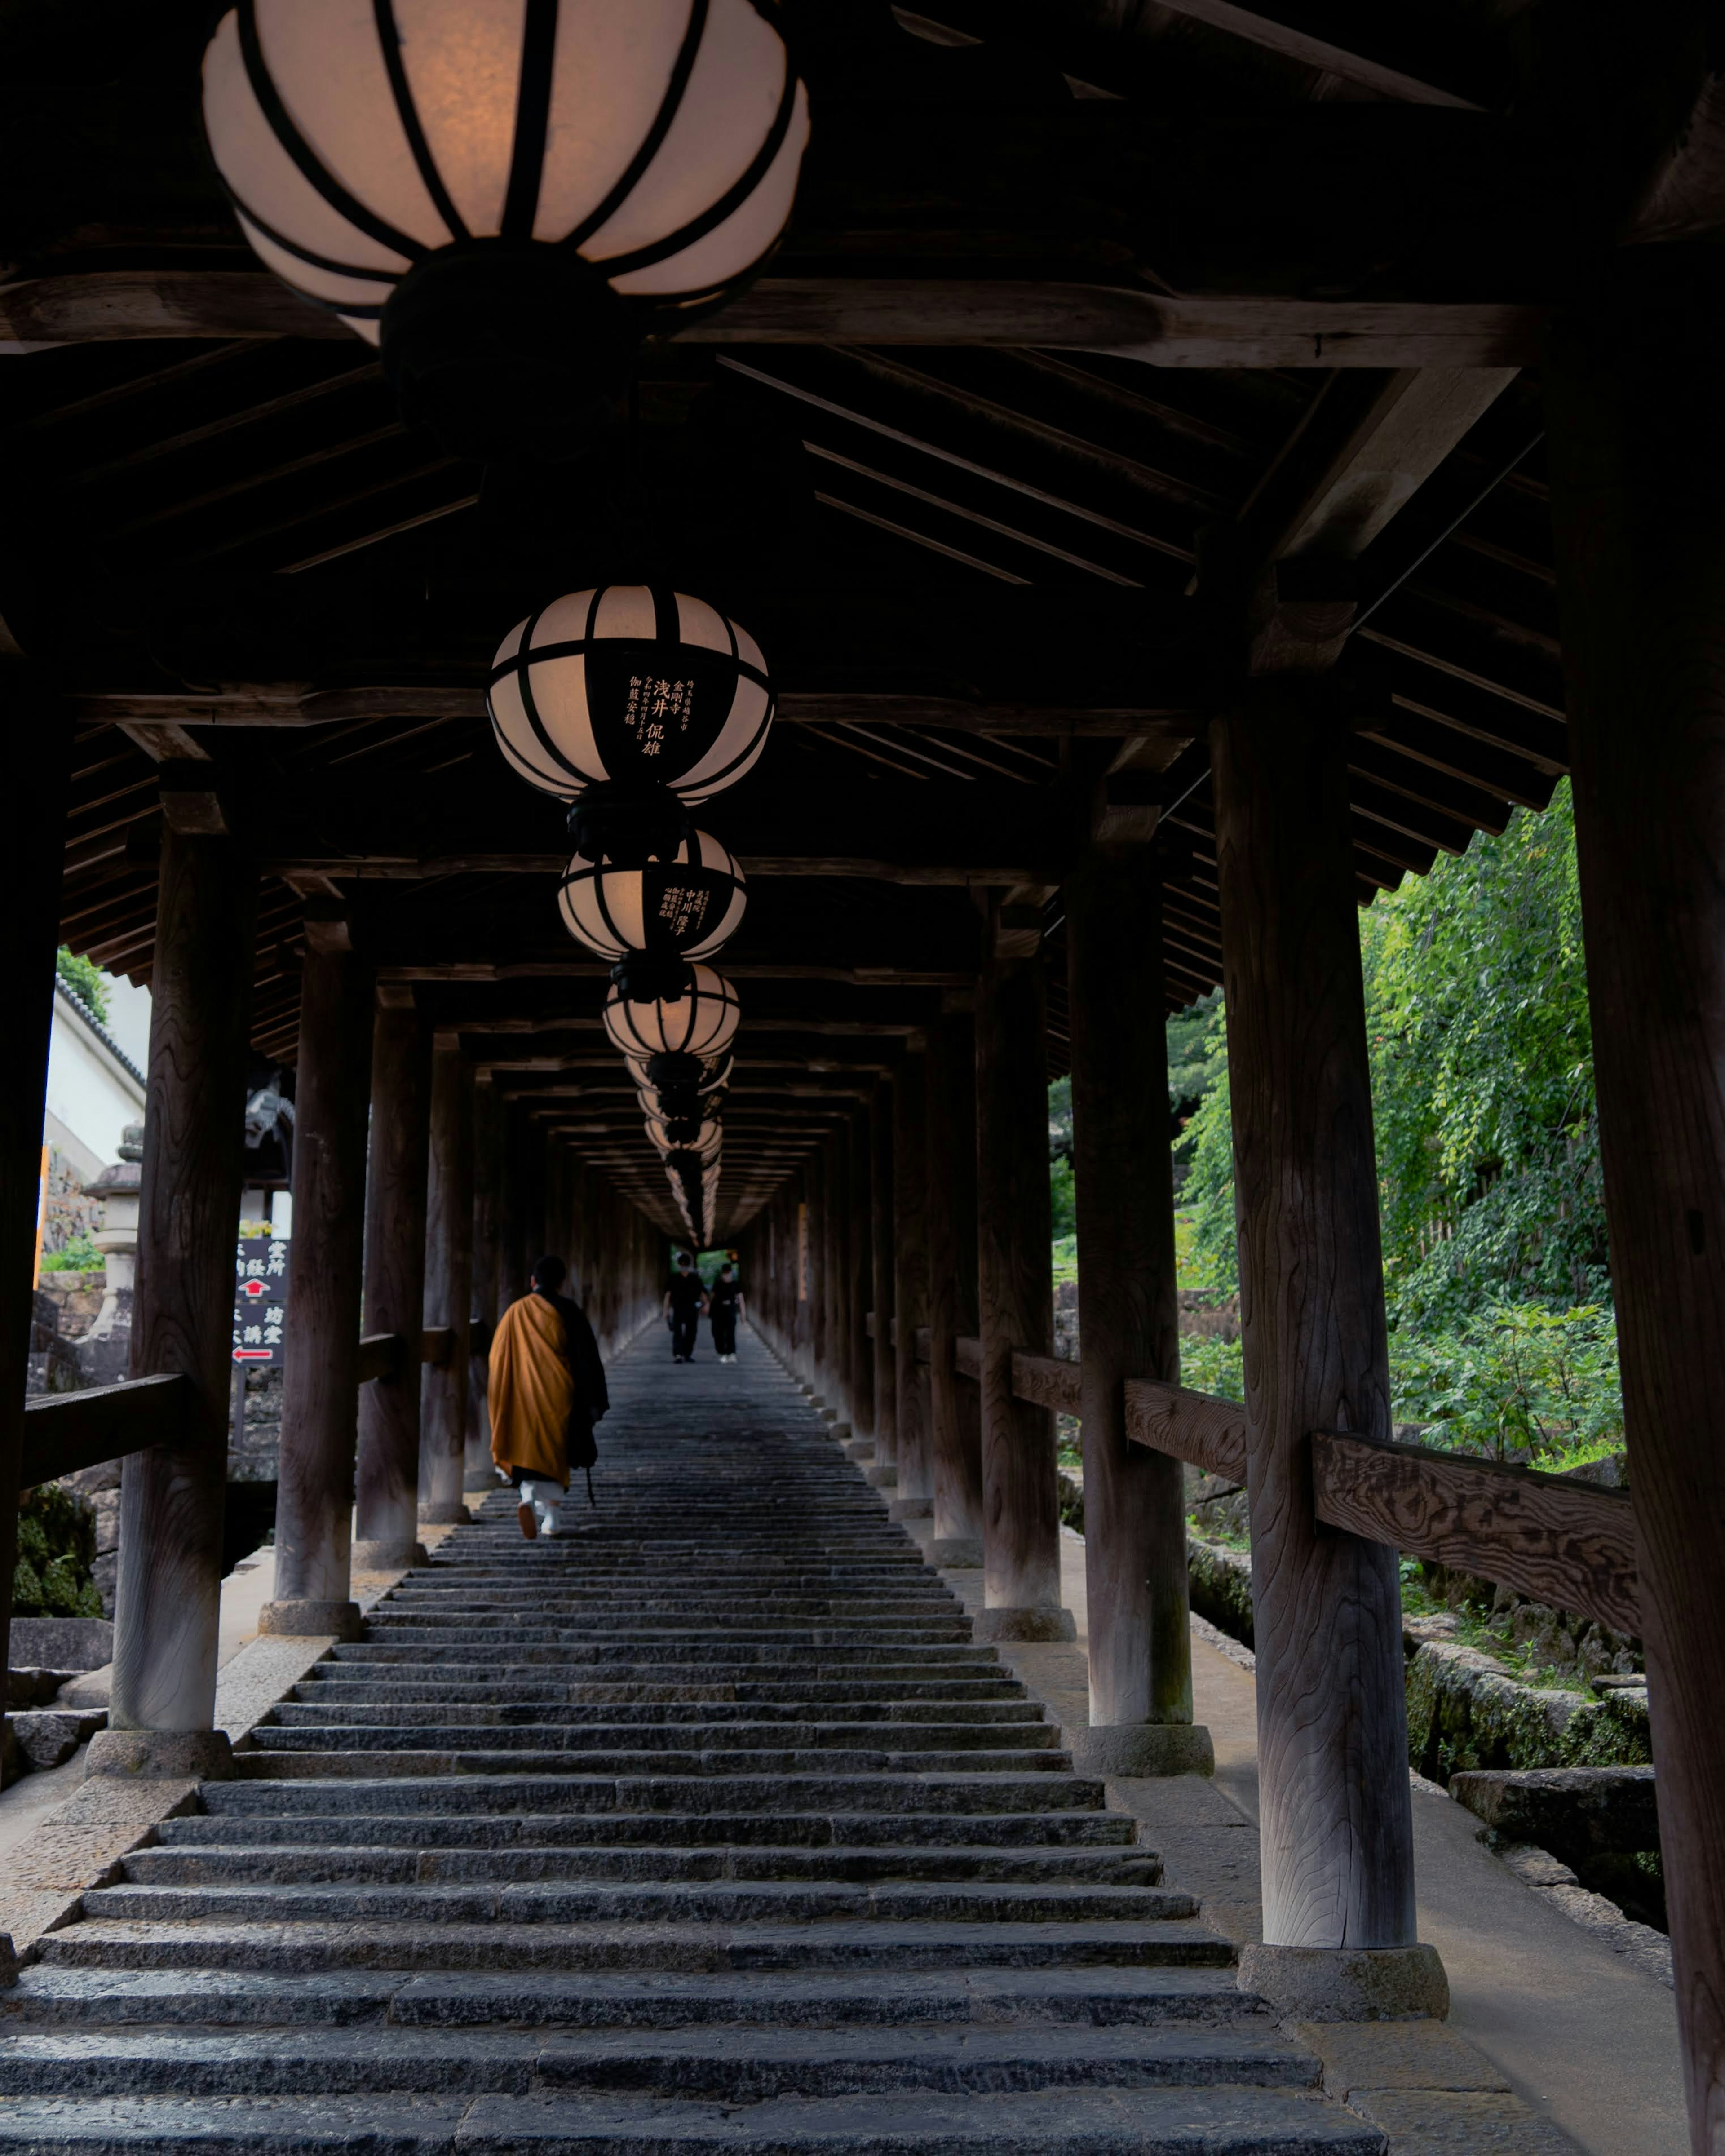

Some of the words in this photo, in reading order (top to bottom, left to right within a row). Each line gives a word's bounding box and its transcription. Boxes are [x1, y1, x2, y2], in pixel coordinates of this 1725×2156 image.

[624, 676, 642, 725] 伽藍安穏
[670, 680, 685, 715] 金剛寺
